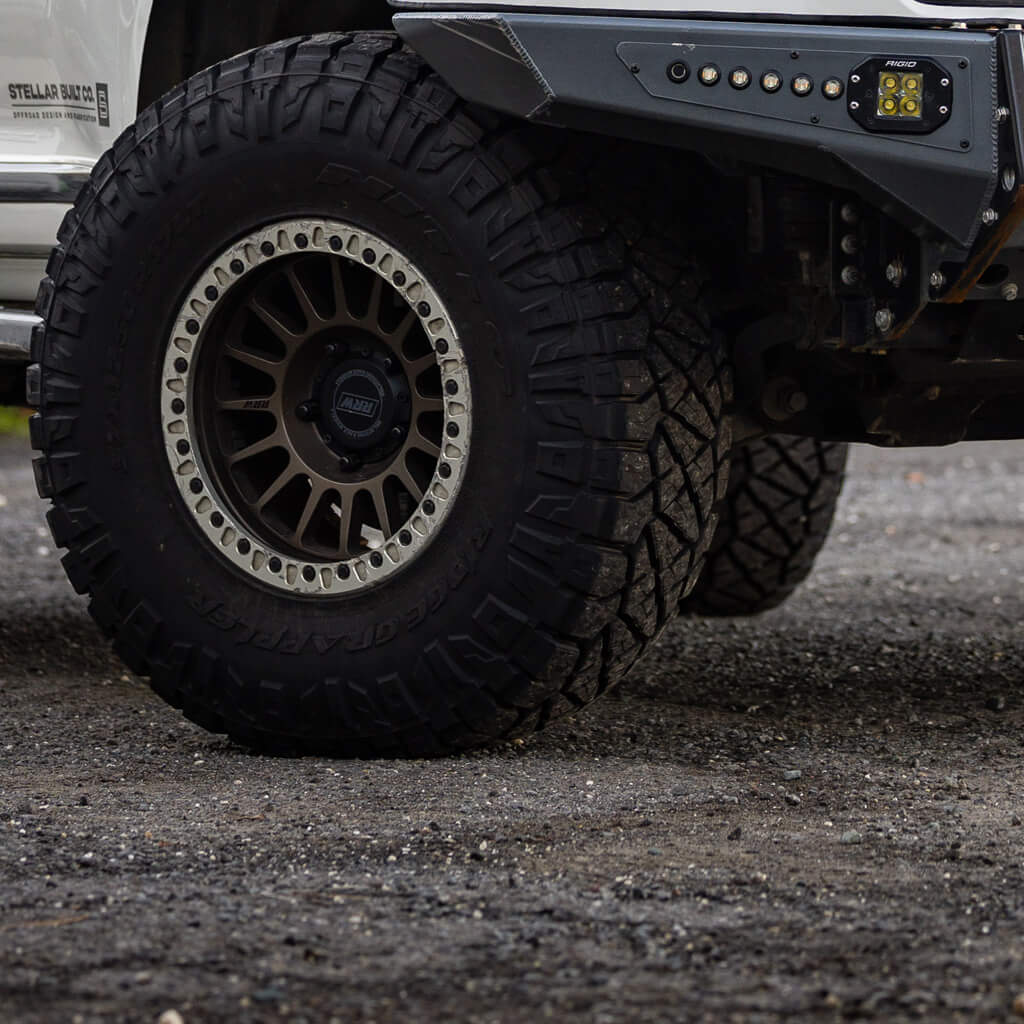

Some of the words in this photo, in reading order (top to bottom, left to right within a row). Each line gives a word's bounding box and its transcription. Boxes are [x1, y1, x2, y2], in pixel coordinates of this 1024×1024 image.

[885, 60, 917, 68] RIGID
[8, 83, 59, 100] STELLAR
[60, 84, 81, 101] BUILT
[82, 85, 95, 102] CO.
[13, 111, 40, 119] OFFROAD
